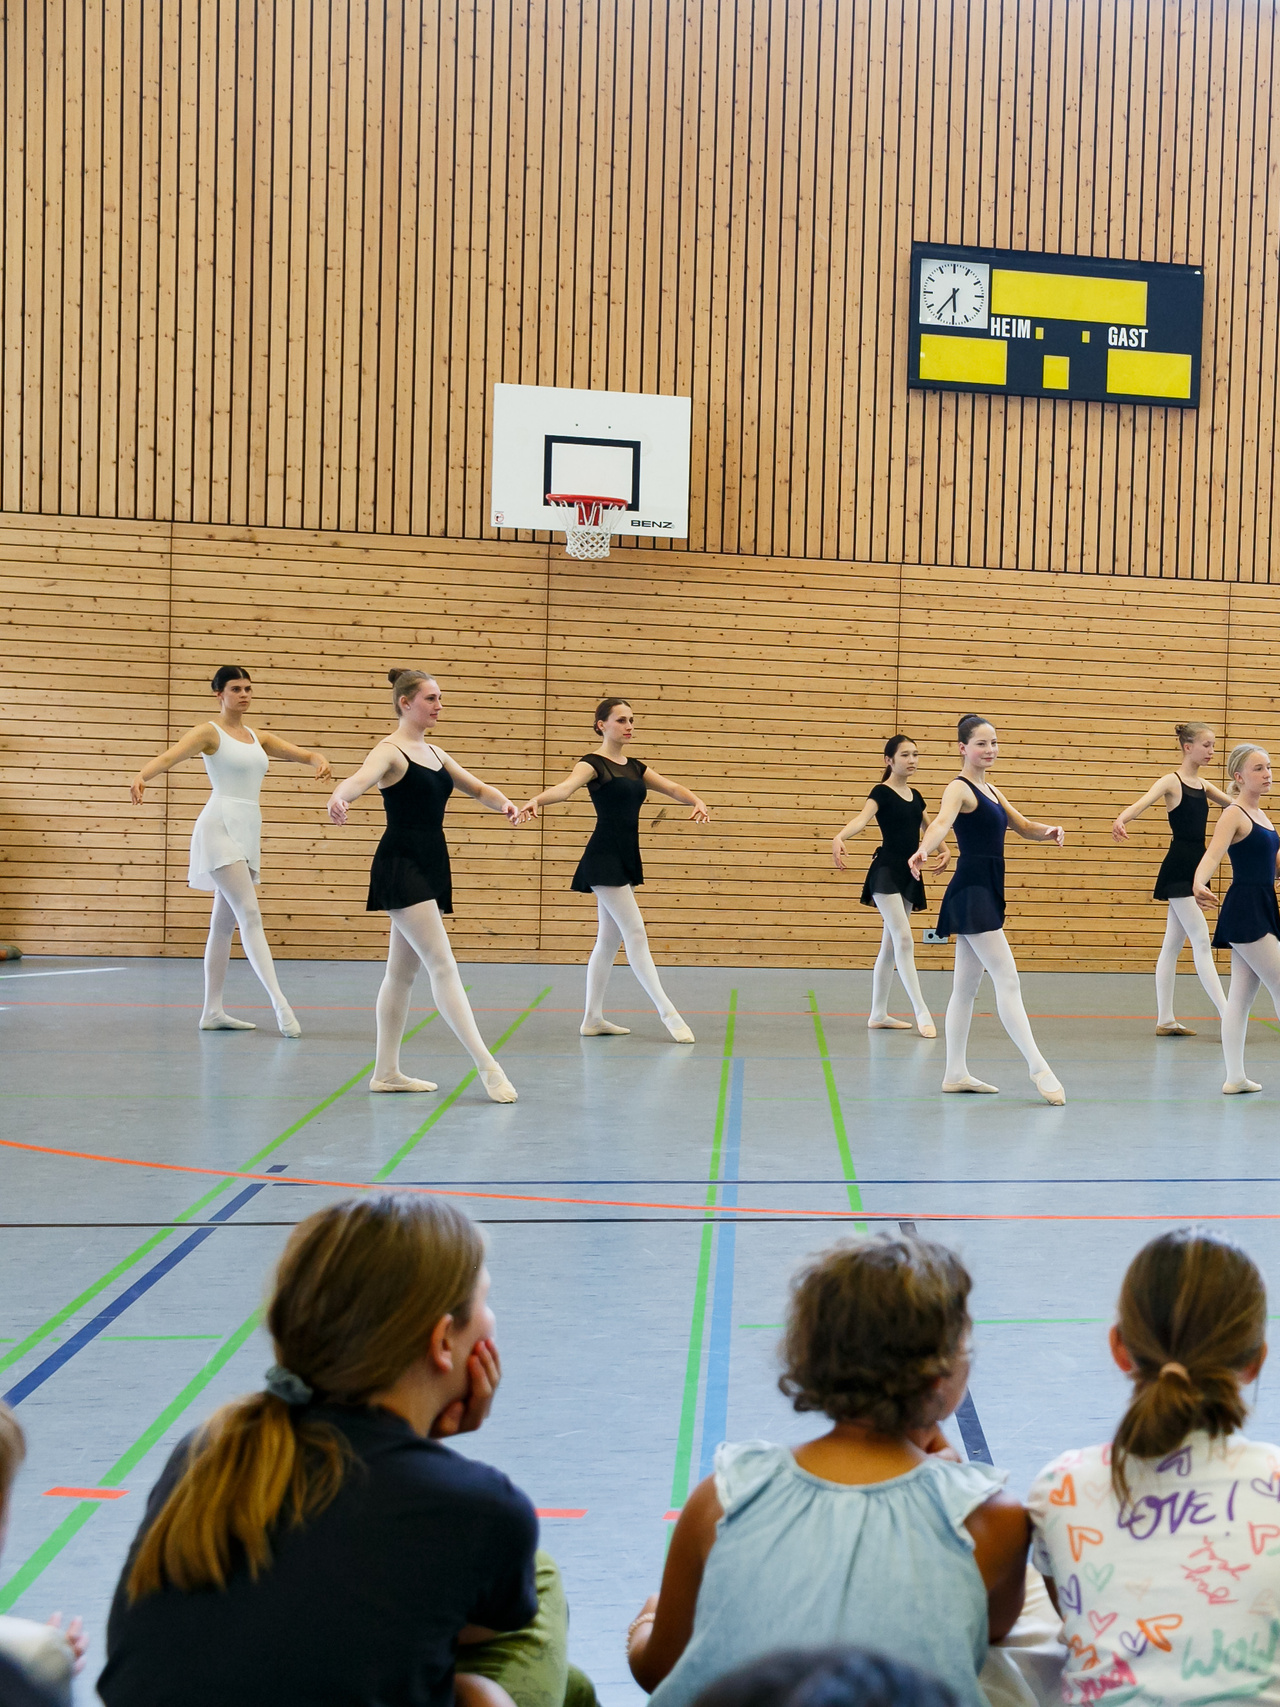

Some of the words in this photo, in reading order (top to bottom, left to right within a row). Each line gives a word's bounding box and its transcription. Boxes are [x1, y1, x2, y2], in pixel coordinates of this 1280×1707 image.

[990, 316, 1031, 339] HEIM
[1108, 326, 1149, 348] GAST
[630, 519, 673, 529] BENZ
